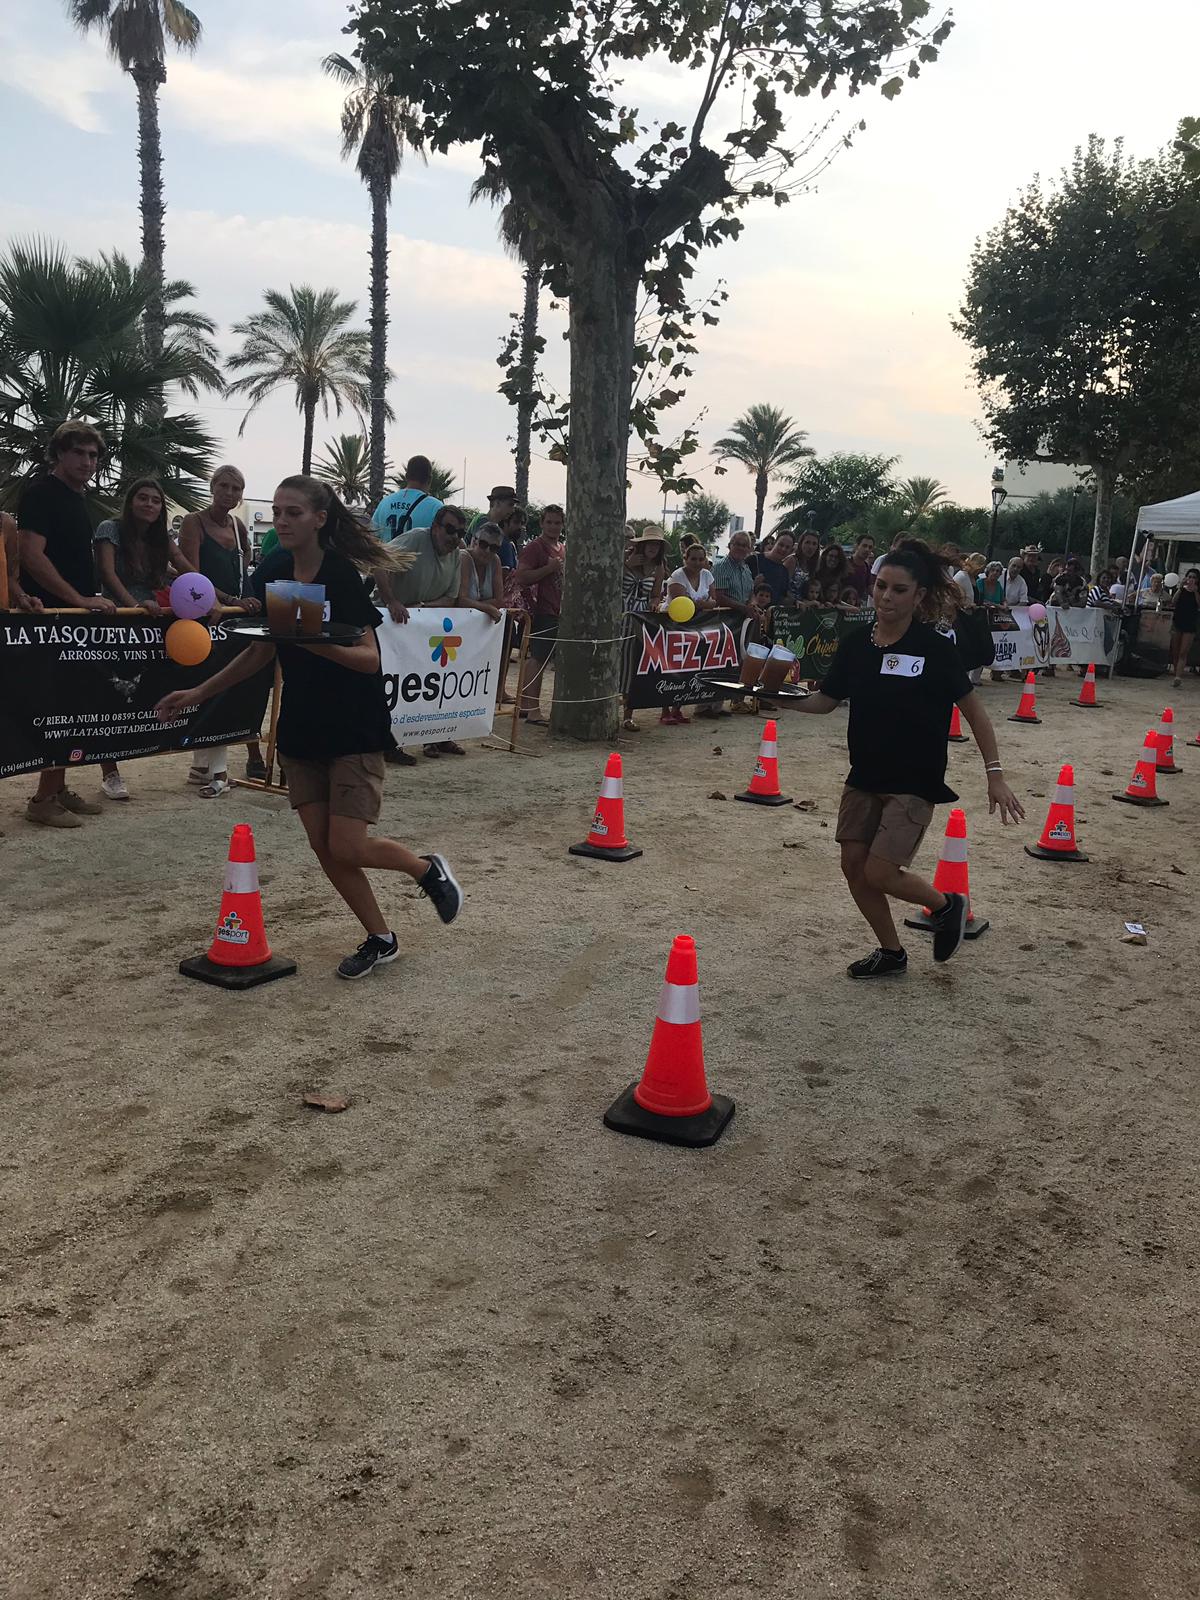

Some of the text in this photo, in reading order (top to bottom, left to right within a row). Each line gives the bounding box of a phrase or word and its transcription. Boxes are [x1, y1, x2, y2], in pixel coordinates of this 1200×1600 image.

[390, 501, 412, 511] MESS
[386, 514, 413, 541] 10
[5, 625, 164, 647] LA TASQUETA DE
[58, 650, 121, 662] ARROSSOS,
[123, 650, 148, 661] VINS
[151, 650, 157, 660] I
[637, 622, 739, 675] MEZZA
[994, 642, 1018, 655] UADRA
[911, 660, 921, 673] 6
[383, 662, 491, 712] gesport
[33, 717, 45, 727] C/
[46, 715, 74, 726] RIERA
[76, 713, 99, 724] NUM
[100, 713, 110, 722] 10
[112, 710, 136, 721] 08393
[402, 725, 458, 738] www.gesport.cat
